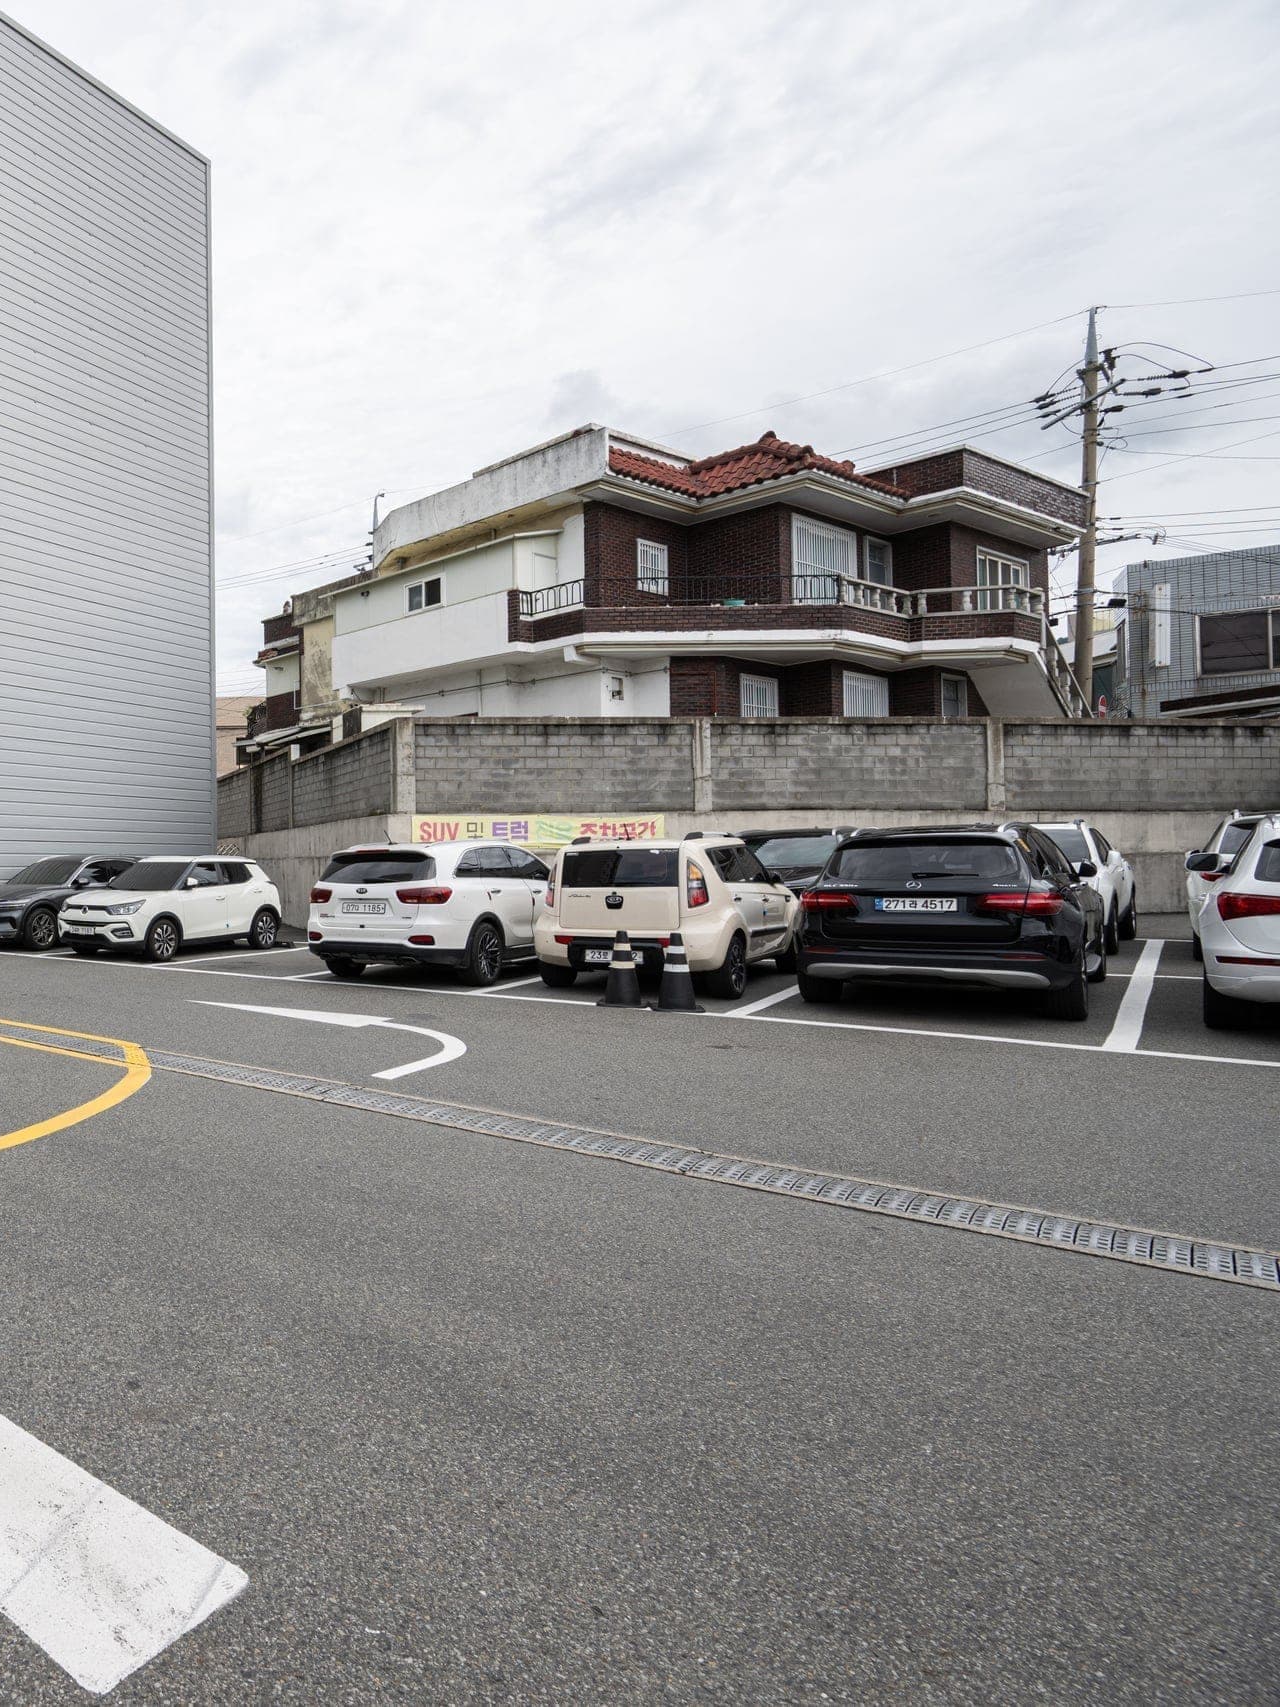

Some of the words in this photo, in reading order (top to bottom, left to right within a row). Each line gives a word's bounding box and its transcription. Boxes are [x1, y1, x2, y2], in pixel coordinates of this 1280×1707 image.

[419, 821, 459, 842] SUV
[491, 820, 529, 842] 트럭
[921, 899, 954, 910] 4517
